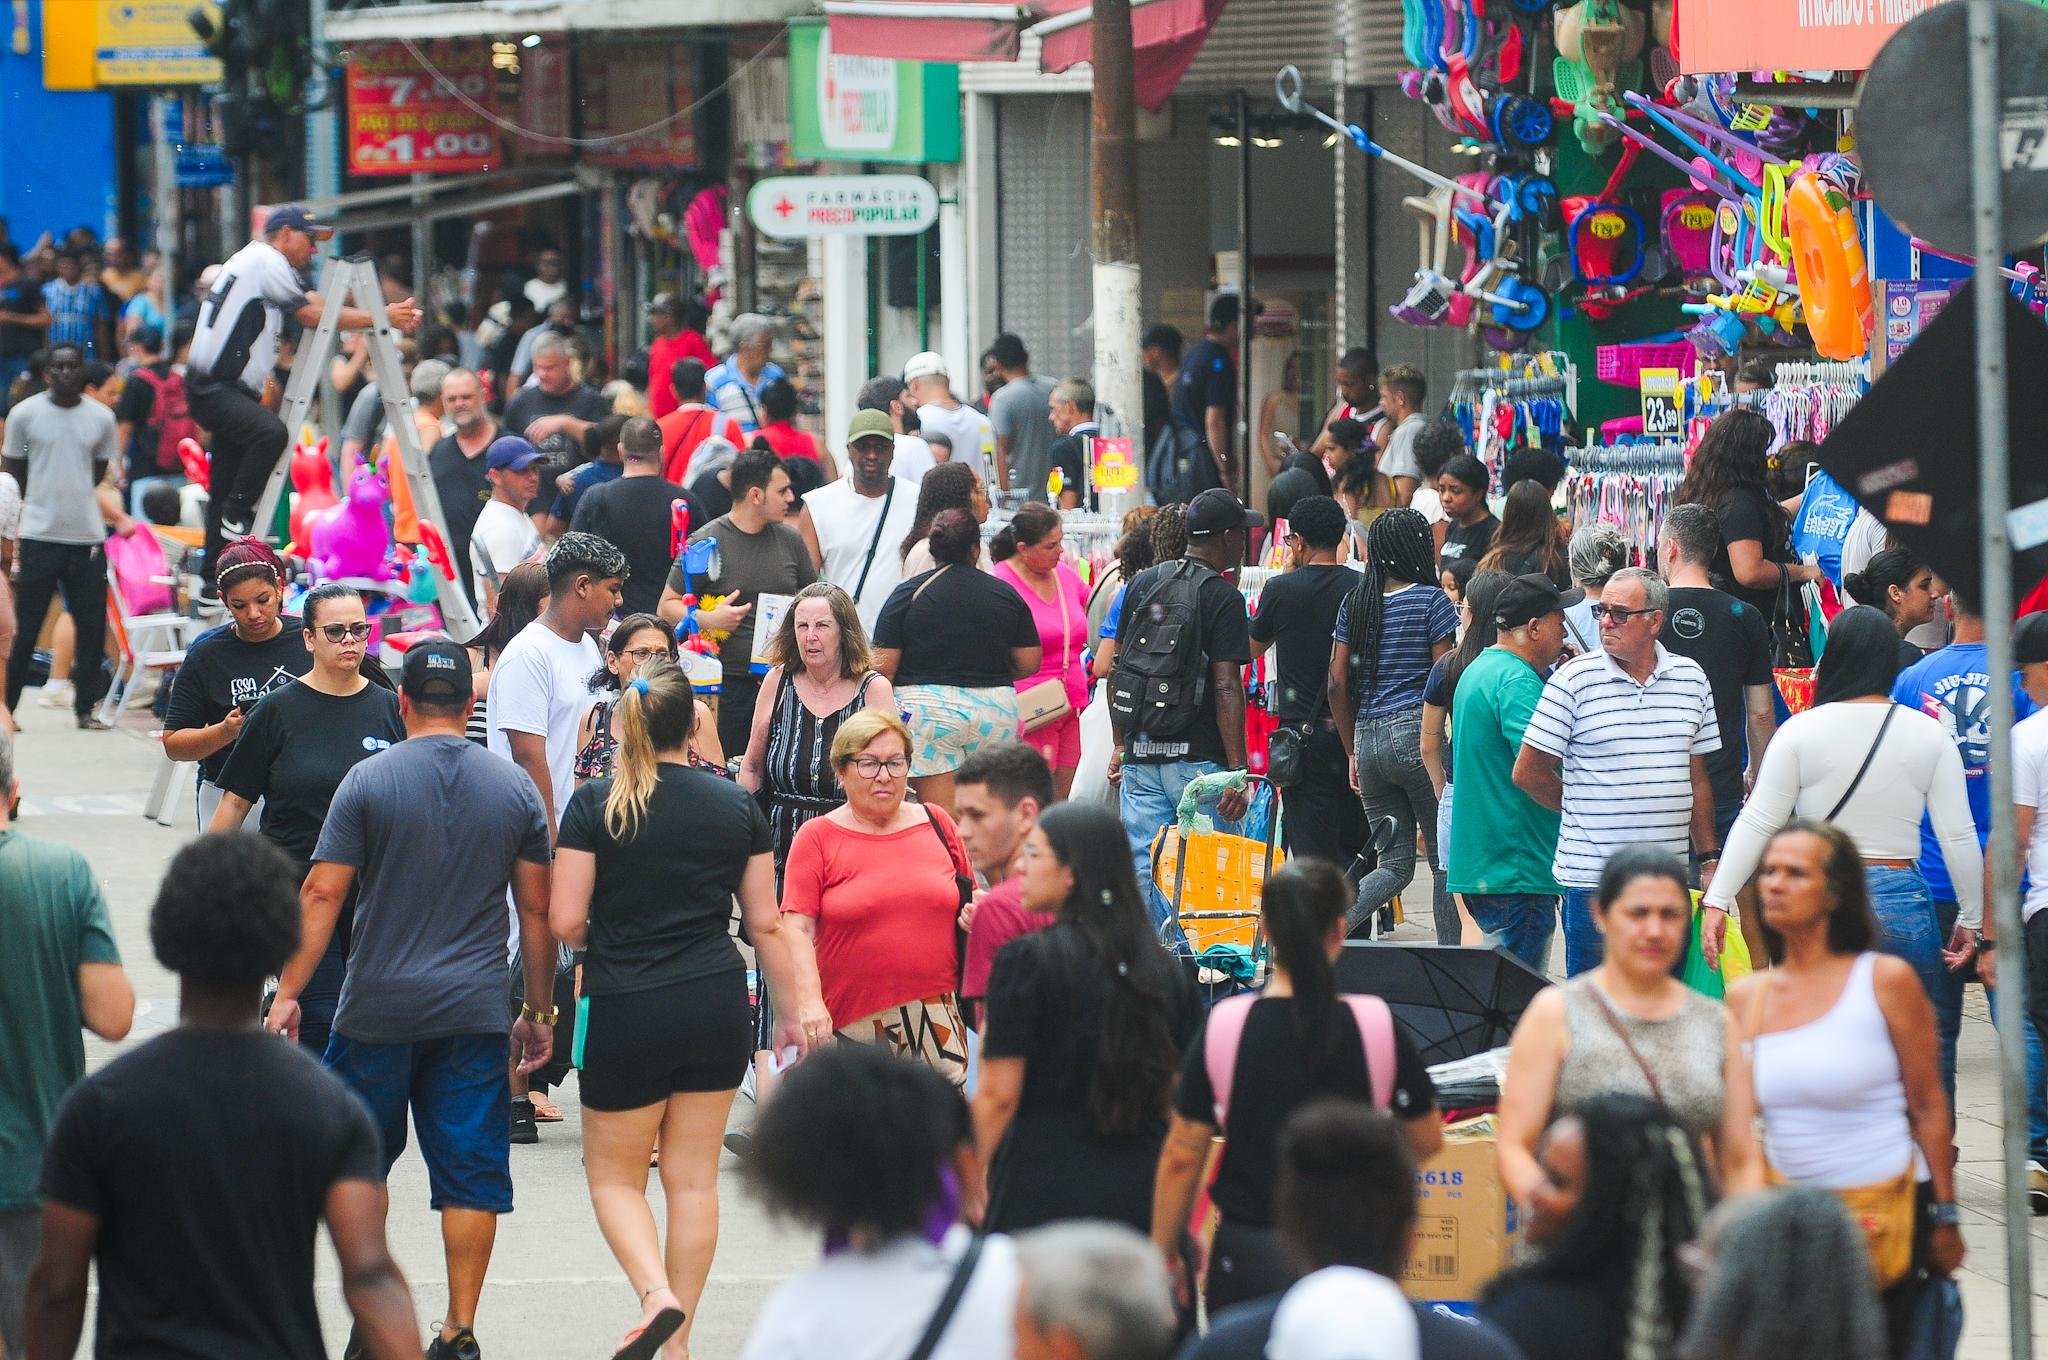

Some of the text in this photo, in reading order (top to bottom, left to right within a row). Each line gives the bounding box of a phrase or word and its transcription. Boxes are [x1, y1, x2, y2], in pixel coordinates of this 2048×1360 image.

[807, 191, 920, 203] FARMÁCIA
[1646, 397, 1677, 432] 23,99
[231, 678, 257, 696] ESSA
